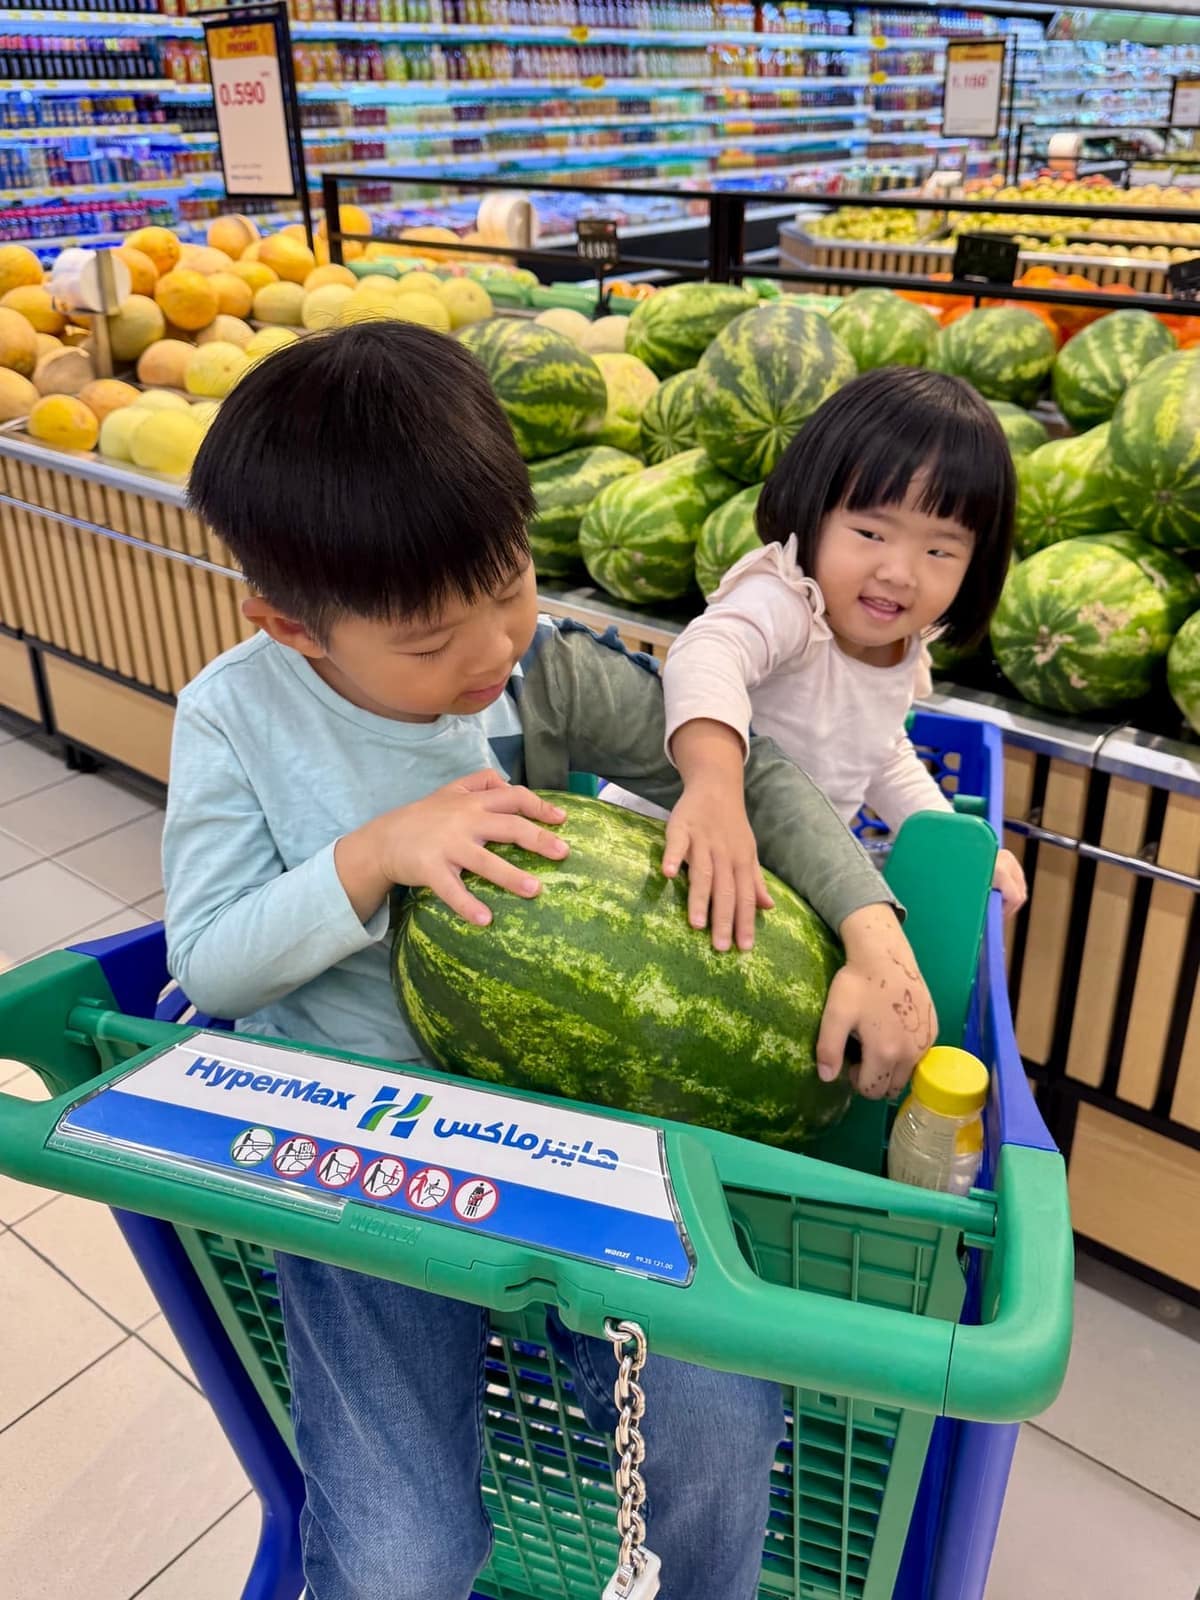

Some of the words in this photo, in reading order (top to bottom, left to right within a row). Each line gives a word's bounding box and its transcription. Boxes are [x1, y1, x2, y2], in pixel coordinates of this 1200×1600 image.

[218, 80, 266, 106] 0.590
[185, 1056, 356, 1111] HyperMax
[433, 1117, 619, 1171] هايبرماكس
